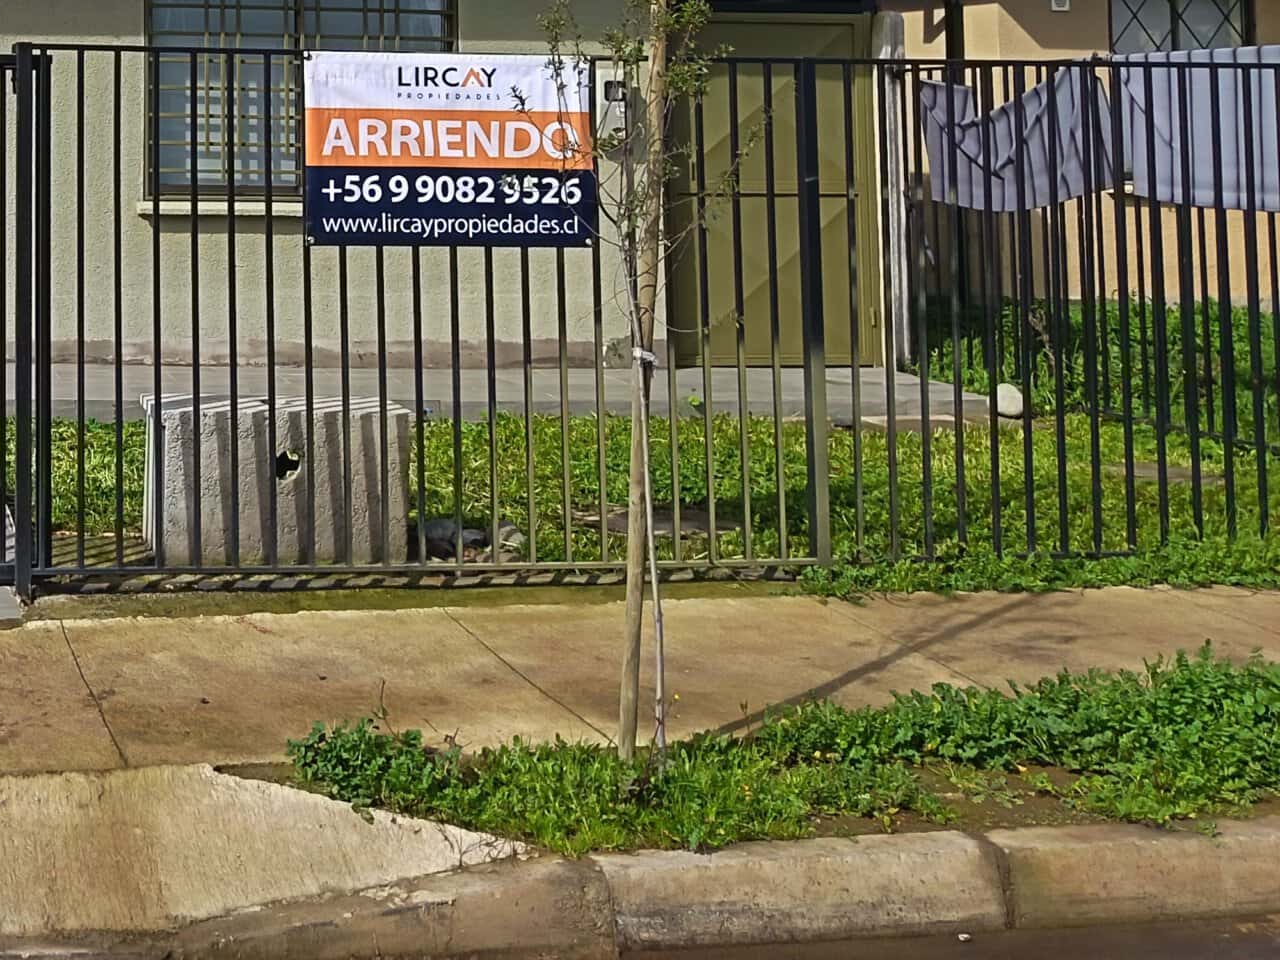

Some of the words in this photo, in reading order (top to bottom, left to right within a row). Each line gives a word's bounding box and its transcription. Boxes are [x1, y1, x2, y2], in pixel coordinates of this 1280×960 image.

[397, 66, 497, 88] LIRCAY
[397, 92, 501, 101] PROPIEDADES
[322, 117, 580, 160] ARRIENDO
[321, 175, 382, 203] +56
[388, 175, 409, 203] 9
[415, 175, 496, 204] 9082
[503, 176, 582, 205] 9526
[322, 213, 579, 238] www.lircaypropiedades.cl
